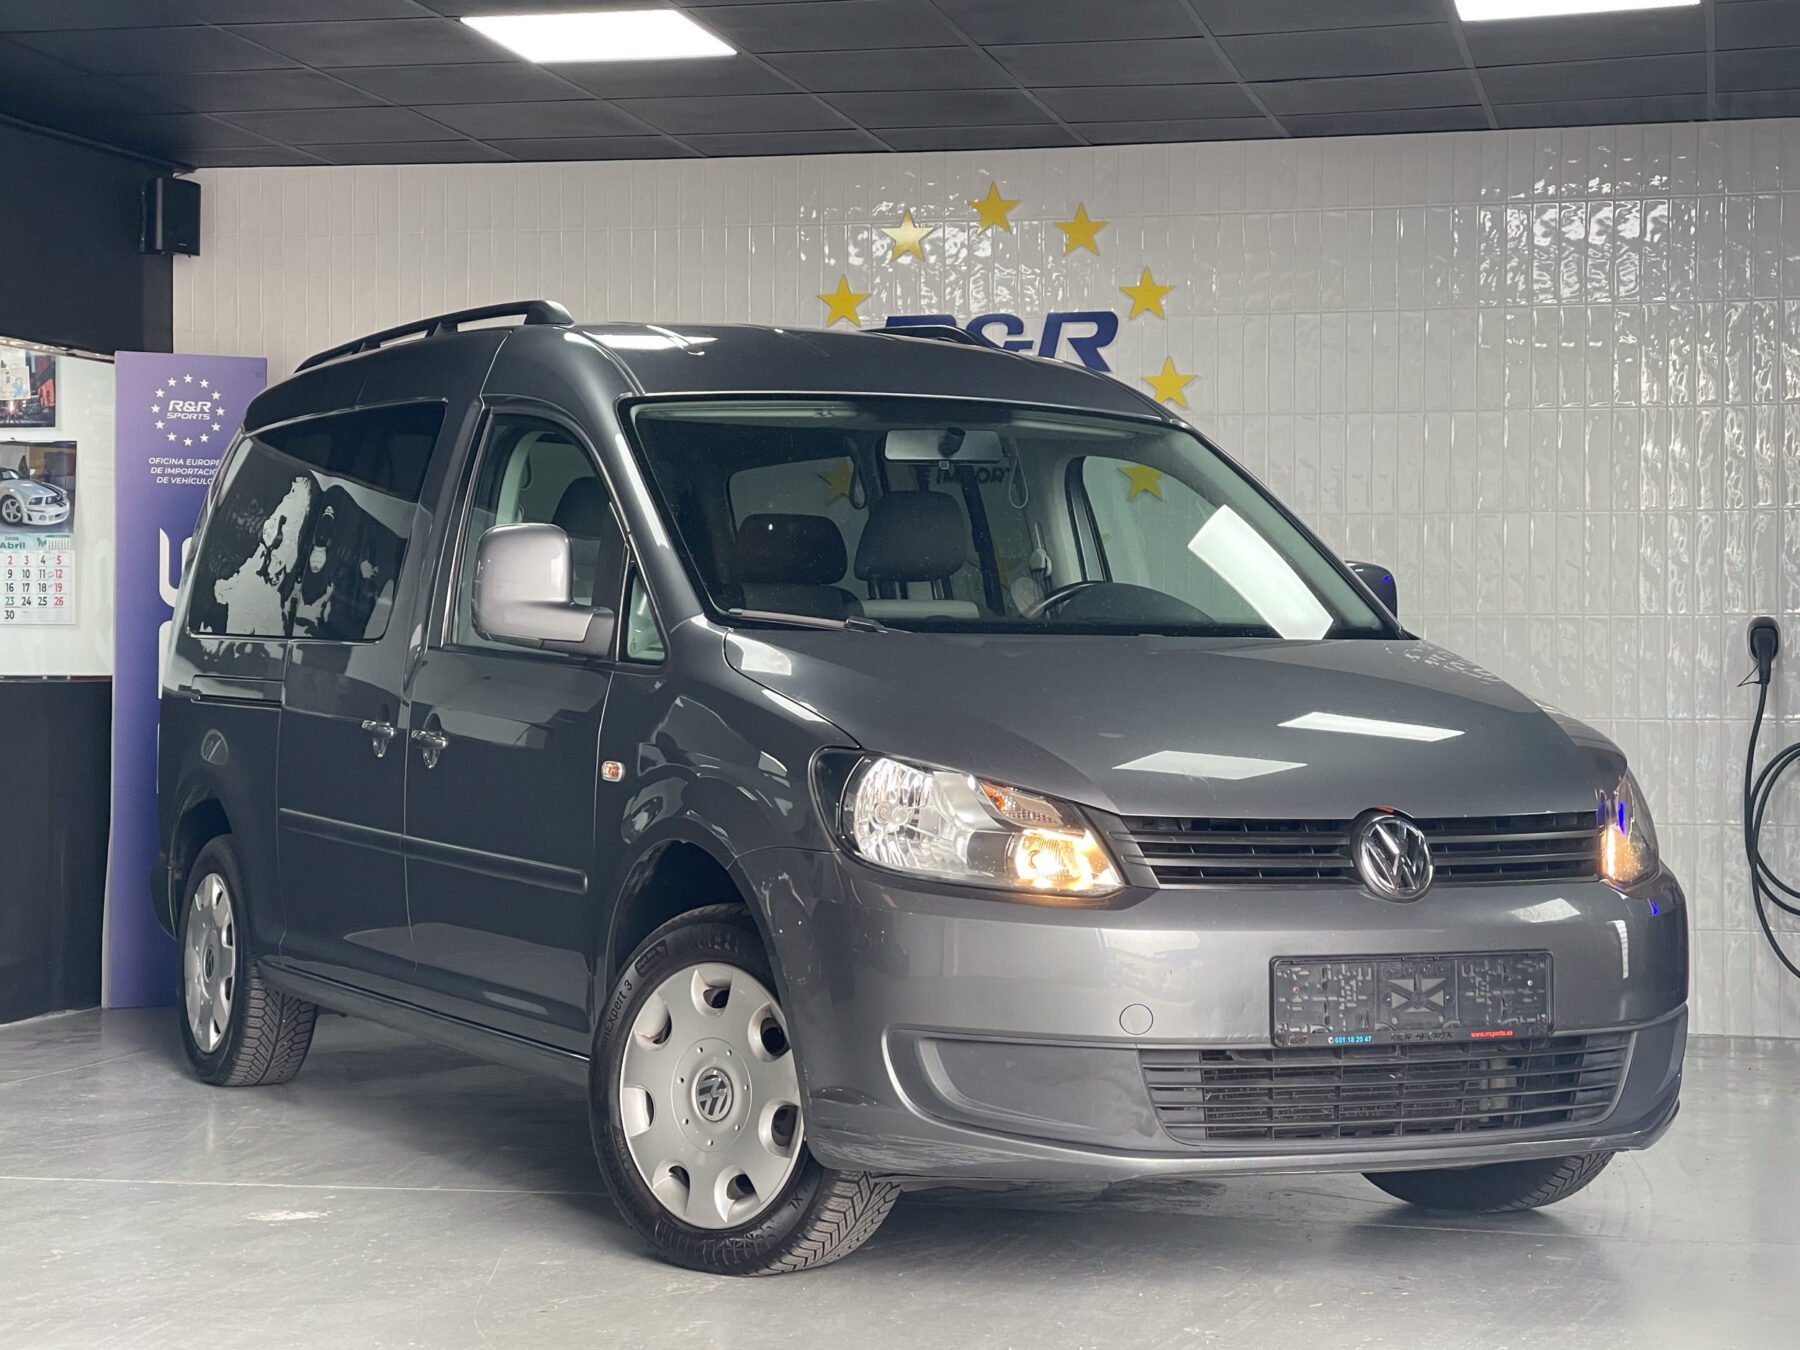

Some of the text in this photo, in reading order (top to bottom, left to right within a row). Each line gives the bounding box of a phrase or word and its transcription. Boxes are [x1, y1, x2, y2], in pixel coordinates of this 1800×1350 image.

[168, 400, 212, 412] R&R
[166, 412, 211, 420] SPORTS
[148, 457, 184, 465] OFICINA
[150, 467, 163, 475] DE
[156, 476, 169, 484] DE
[8, 555, 62, 565] 2 3 4 5
[7, 569, 63, 579] 9 10 11 12
[5, 582, 63, 593] 16 17 18 19
[5, 596, 64, 606] 23 24 25 26
[4, 610, 15, 620] 30
[624, 979, 633, 991] 3
